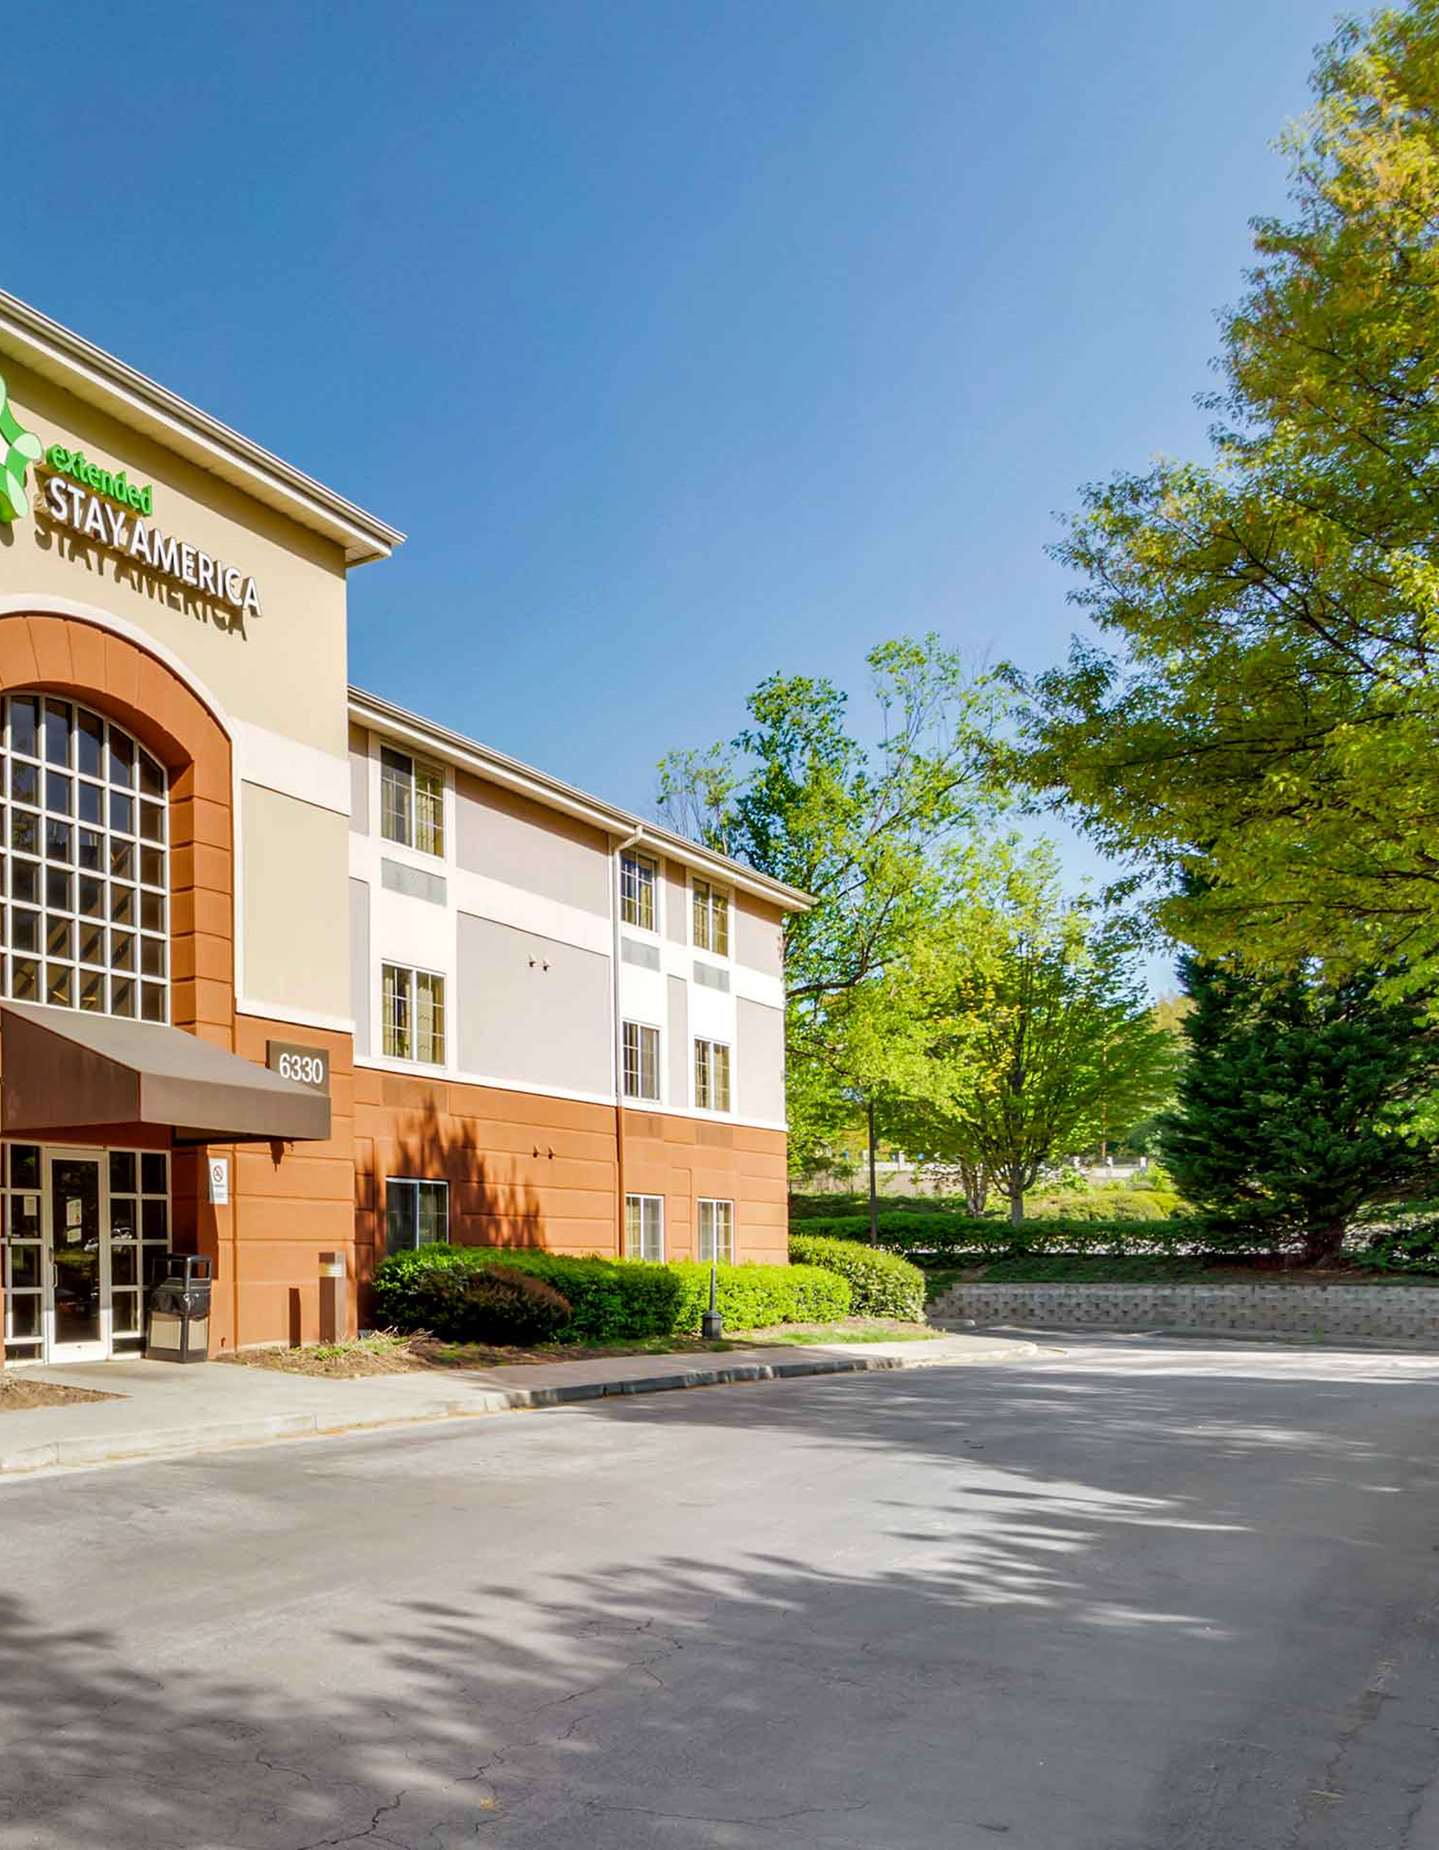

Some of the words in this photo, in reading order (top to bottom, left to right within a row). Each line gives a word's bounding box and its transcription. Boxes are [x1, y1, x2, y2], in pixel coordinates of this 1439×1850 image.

[47, 444, 153, 517] extended
[47, 477, 126, 548] STAY
[129, 519, 263, 618] AMERICA
[280, 1053, 324, 1084] 6330
